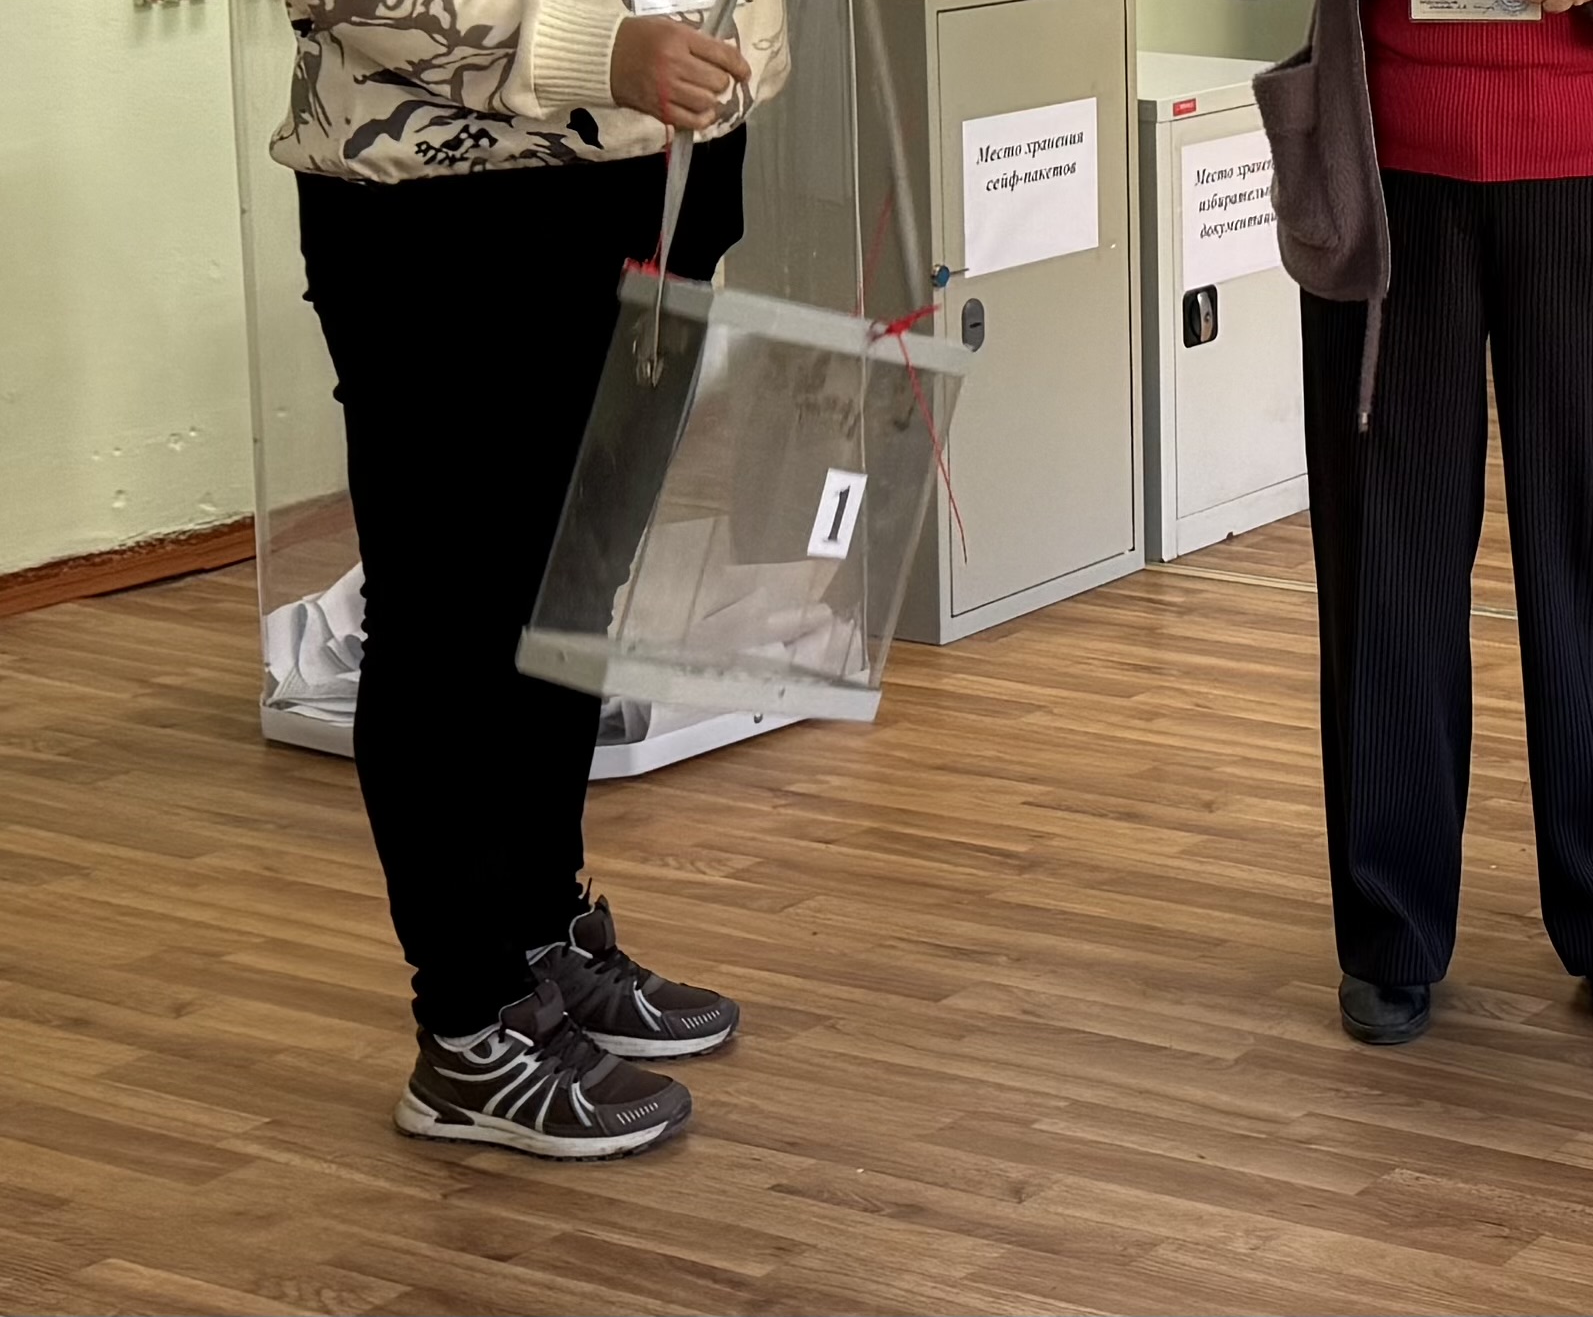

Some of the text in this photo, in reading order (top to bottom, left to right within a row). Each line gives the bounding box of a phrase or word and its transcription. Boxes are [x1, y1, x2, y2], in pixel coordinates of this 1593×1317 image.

[976, 131, 1084, 166] Место хранения
[985, 161, 1077, 192] сейф-пакетов
[1194, 167, 1234, 187] Место
[822, 484, 851, 543] 1
